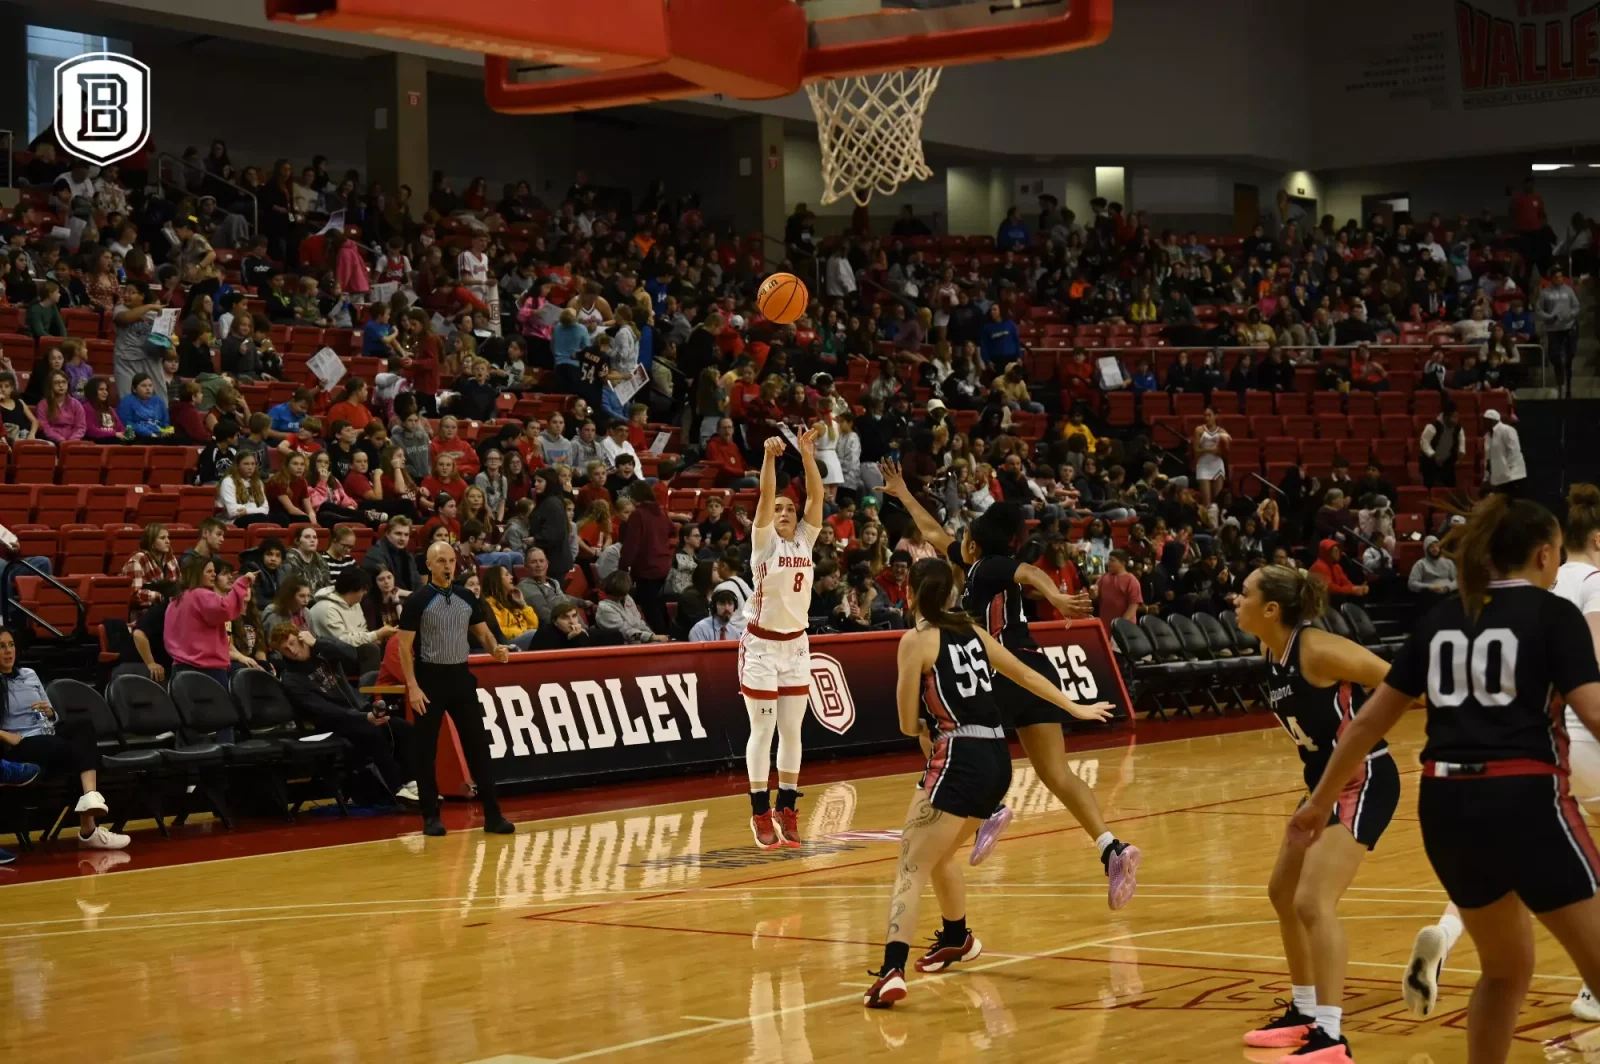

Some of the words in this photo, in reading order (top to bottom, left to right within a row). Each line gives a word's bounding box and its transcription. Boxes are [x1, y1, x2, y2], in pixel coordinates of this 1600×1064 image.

[580, 361, 595, 384] 54
[793, 572, 804, 592] 8
[811, 668, 845, 718] B
[948, 637, 993, 699] 55
[1037, 645, 1098, 701] ES
[1427, 628, 1520, 708] 00
[476, 672, 707, 759] BRADLEY
